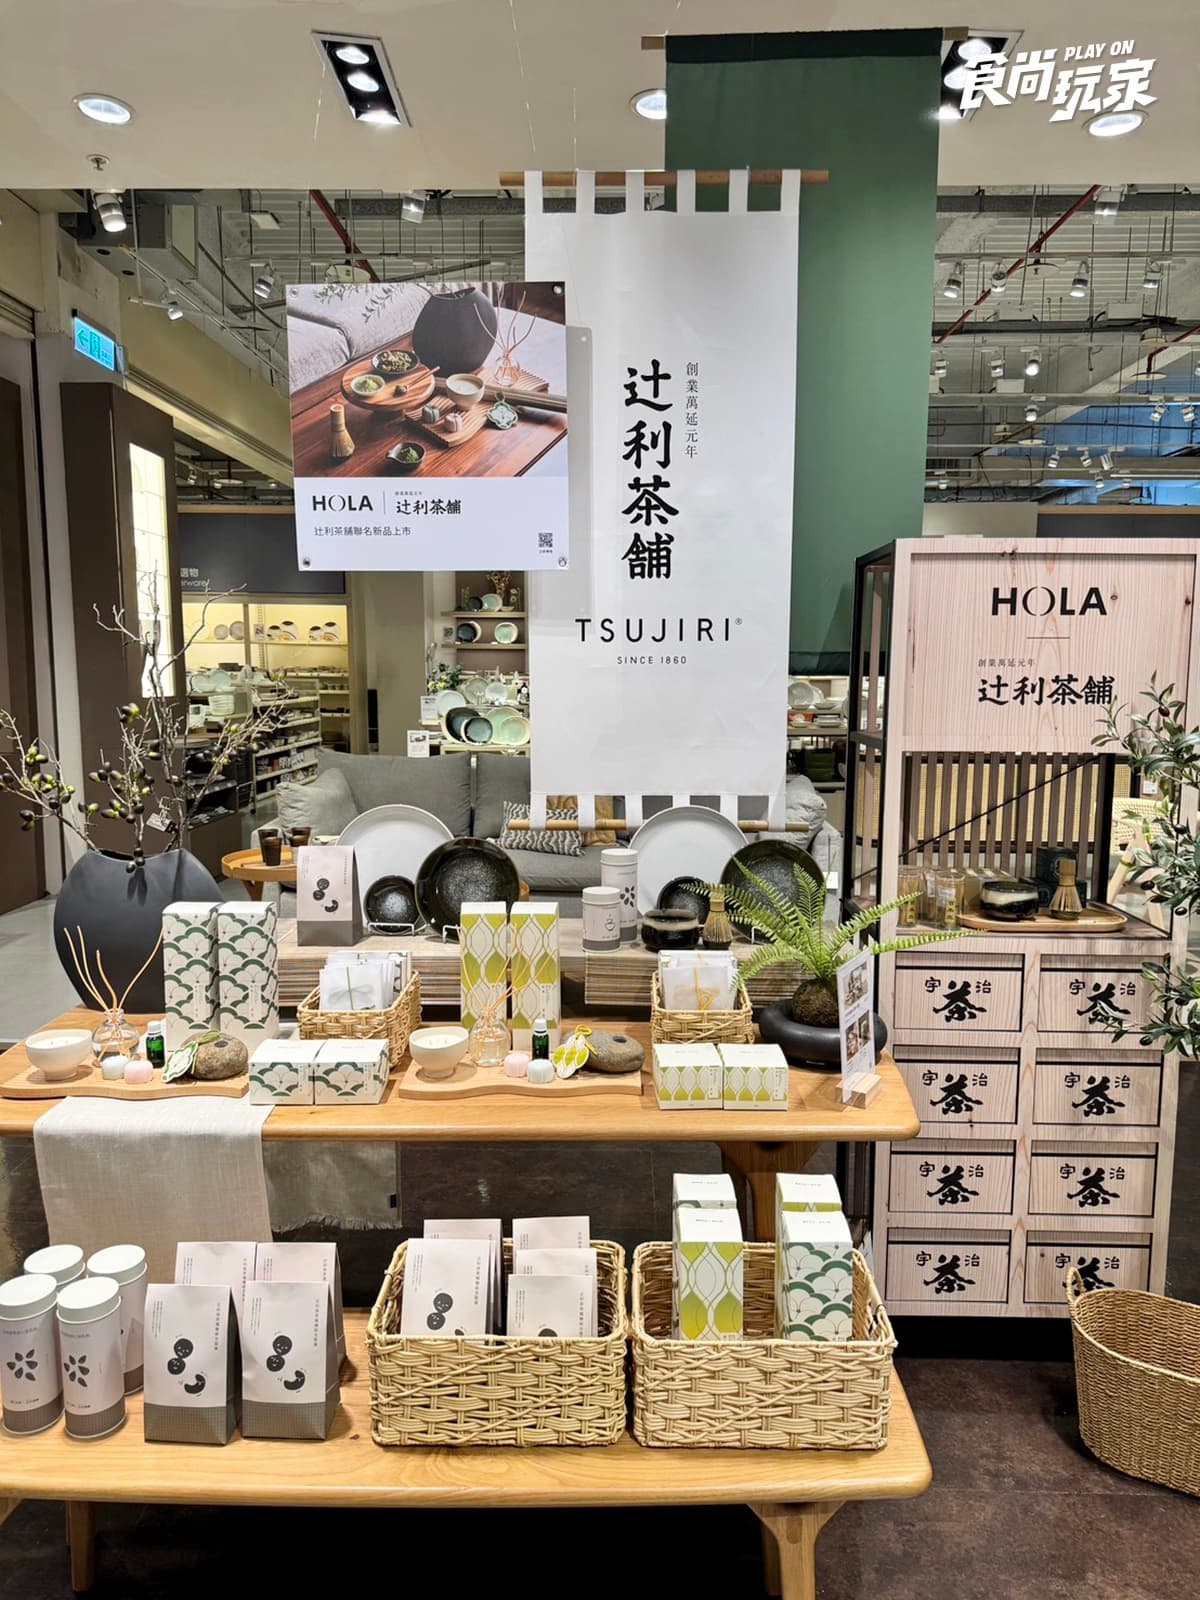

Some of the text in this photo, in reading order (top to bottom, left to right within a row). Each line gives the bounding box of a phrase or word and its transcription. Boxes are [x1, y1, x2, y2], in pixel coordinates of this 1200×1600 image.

[685, 361, 699, 459] 創業萬延元年
[312, 494, 374, 512] HOLA
[991, 586, 1107, 617] HOLA
[616, 655, 687, 665] SINCE 1860
